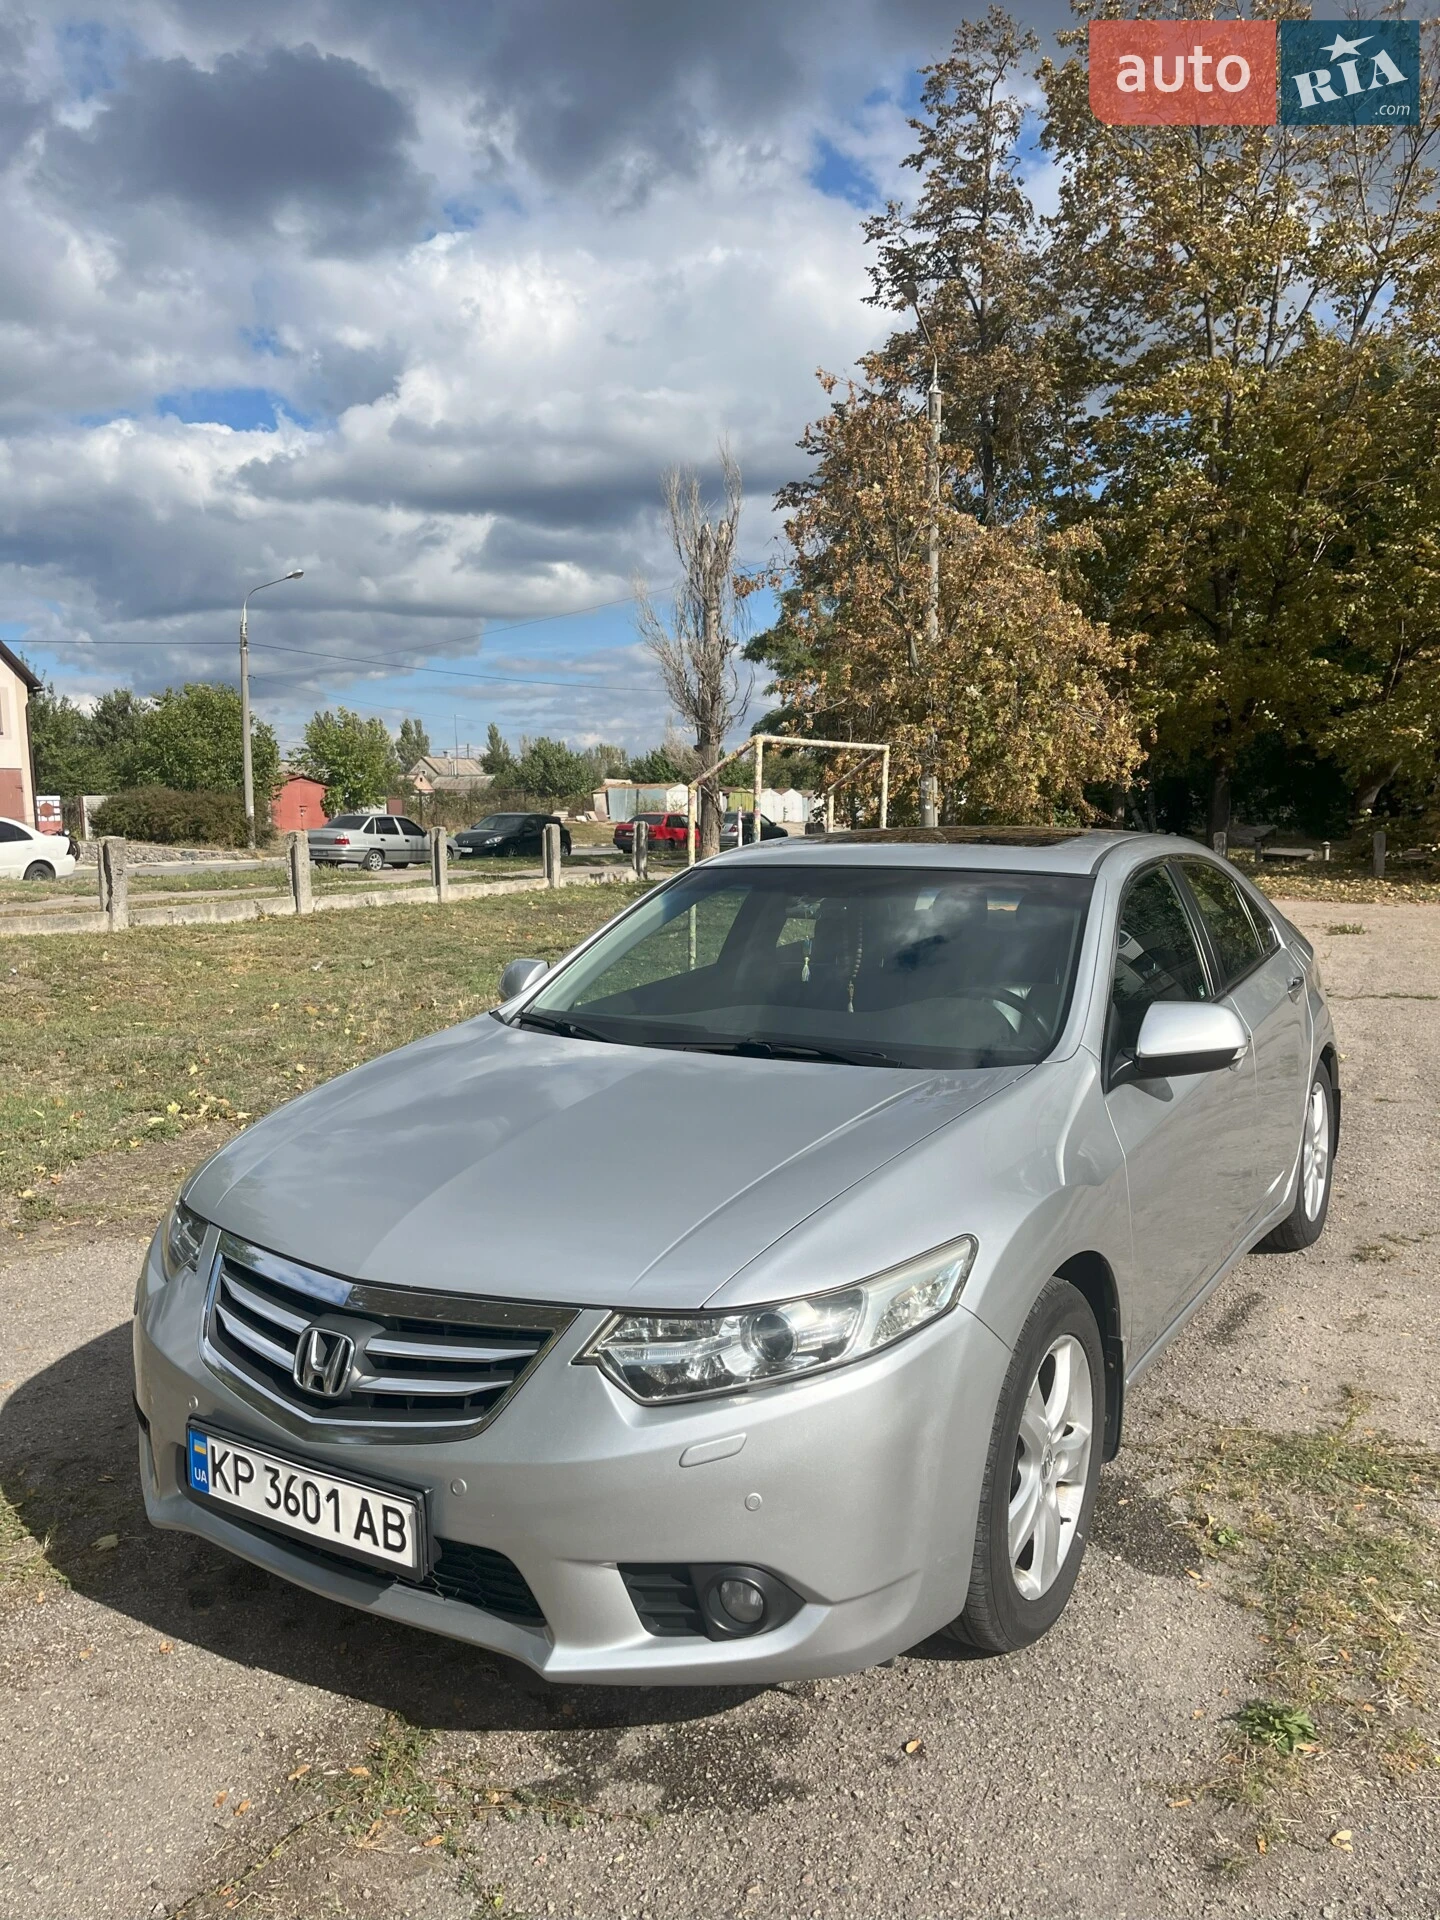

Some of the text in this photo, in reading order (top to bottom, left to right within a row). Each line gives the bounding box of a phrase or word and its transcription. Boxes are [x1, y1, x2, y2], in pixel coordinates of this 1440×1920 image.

[194, 1467, 208, 1484] UA
[210, 1445, 408, 1553] KP 3601 AB
